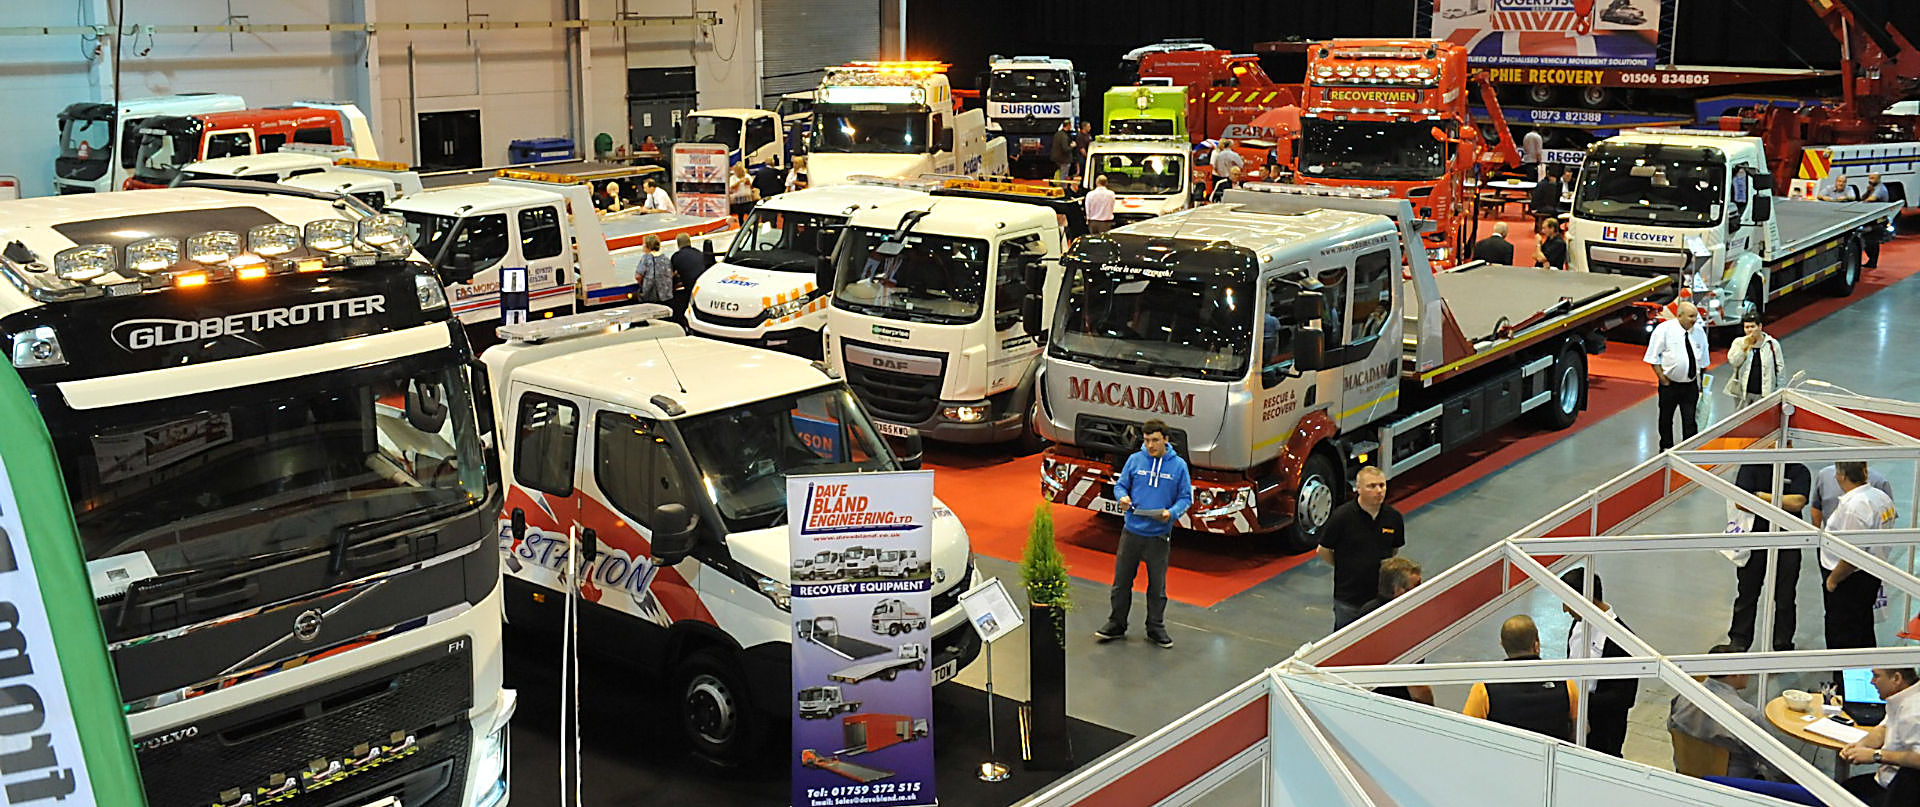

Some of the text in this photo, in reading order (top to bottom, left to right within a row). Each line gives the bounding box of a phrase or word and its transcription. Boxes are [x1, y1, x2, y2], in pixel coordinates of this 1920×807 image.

[1489, 56, 1499, 64] OF
[1500, 56, 1540, 65] SPECIALISED
[1541, 57, 1567, 65] VEHICLE
[1569, 58, 1608, 66] MOVEMENT
[1609, 59, 1648, 67] SOLUTIONS
[1529, 69, 1604, 84] RECOVERY
[1621, 73, 1709, 84] 01506 834805
[1331, 91, 1416, 102] RECOVERYMEN
[1001, 104, 1061, 114] BURROWS
[1530, 110, 1601, 122] 01873 821388
[1623, 232, 1674, 243] RECOVERY
[1618, 255, 1655, 264] DAF
[1100, 263, 1122, 272] Service
[710, 300, 739, 311] IVECO
[129, 295, 385, 349] GLOBETROTTER
[872, 357, 908, 370] DAF
[1068, 376, 1195, 417] MACADAM
[1263, 393, 1289, 409] RESCUE
[1262, 402, 1297, 422] RECOVERY
[816, 485, 848, 497] DAVE
[812, 496, 868, 514] BLAND
[809, 511, 912, 528] ENGINEERING LTD
[800, 580, 924, 596] RECOVERY EQUIPMENT
[448, 641, 465, 653] FH
[807, 782, 921, 798] Tel: 01759 372 515
[811, 798, 833, 807] Email:
